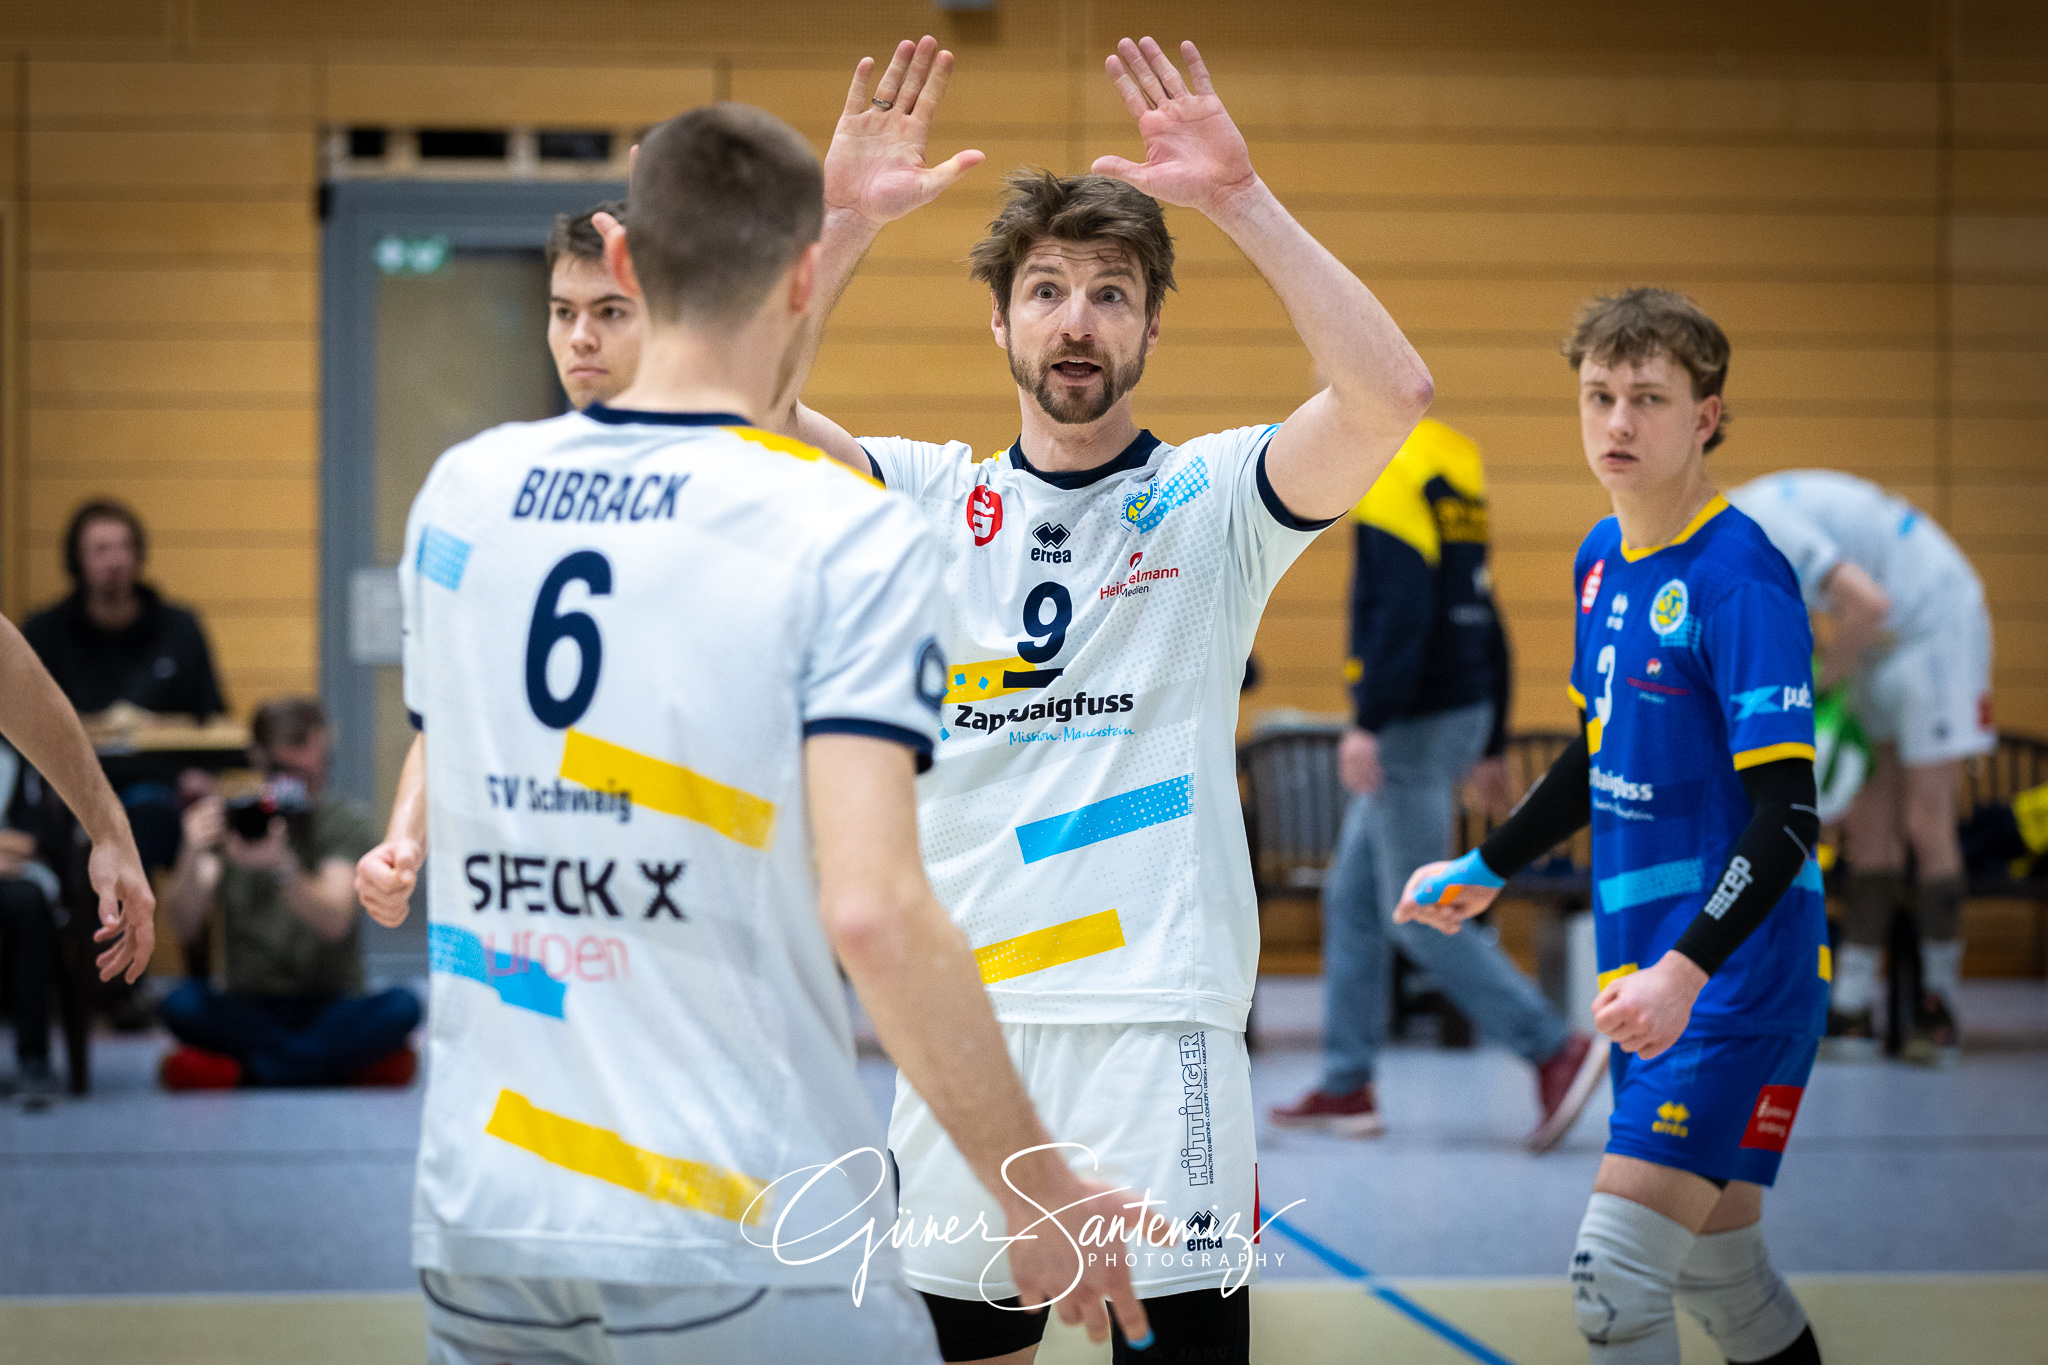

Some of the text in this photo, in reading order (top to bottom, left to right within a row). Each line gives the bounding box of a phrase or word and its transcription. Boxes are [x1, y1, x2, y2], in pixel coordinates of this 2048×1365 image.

[511, 467, 692, 523] BIBRACK
[1030, 548, 1072, 564] errea
[524, 549, 615, 731] 6
[1017, 581, 1073, 664] 9
[1594, 644, 1616, 729] 3
[1009, 724, 1136, 746] Mission: Mauerstein
